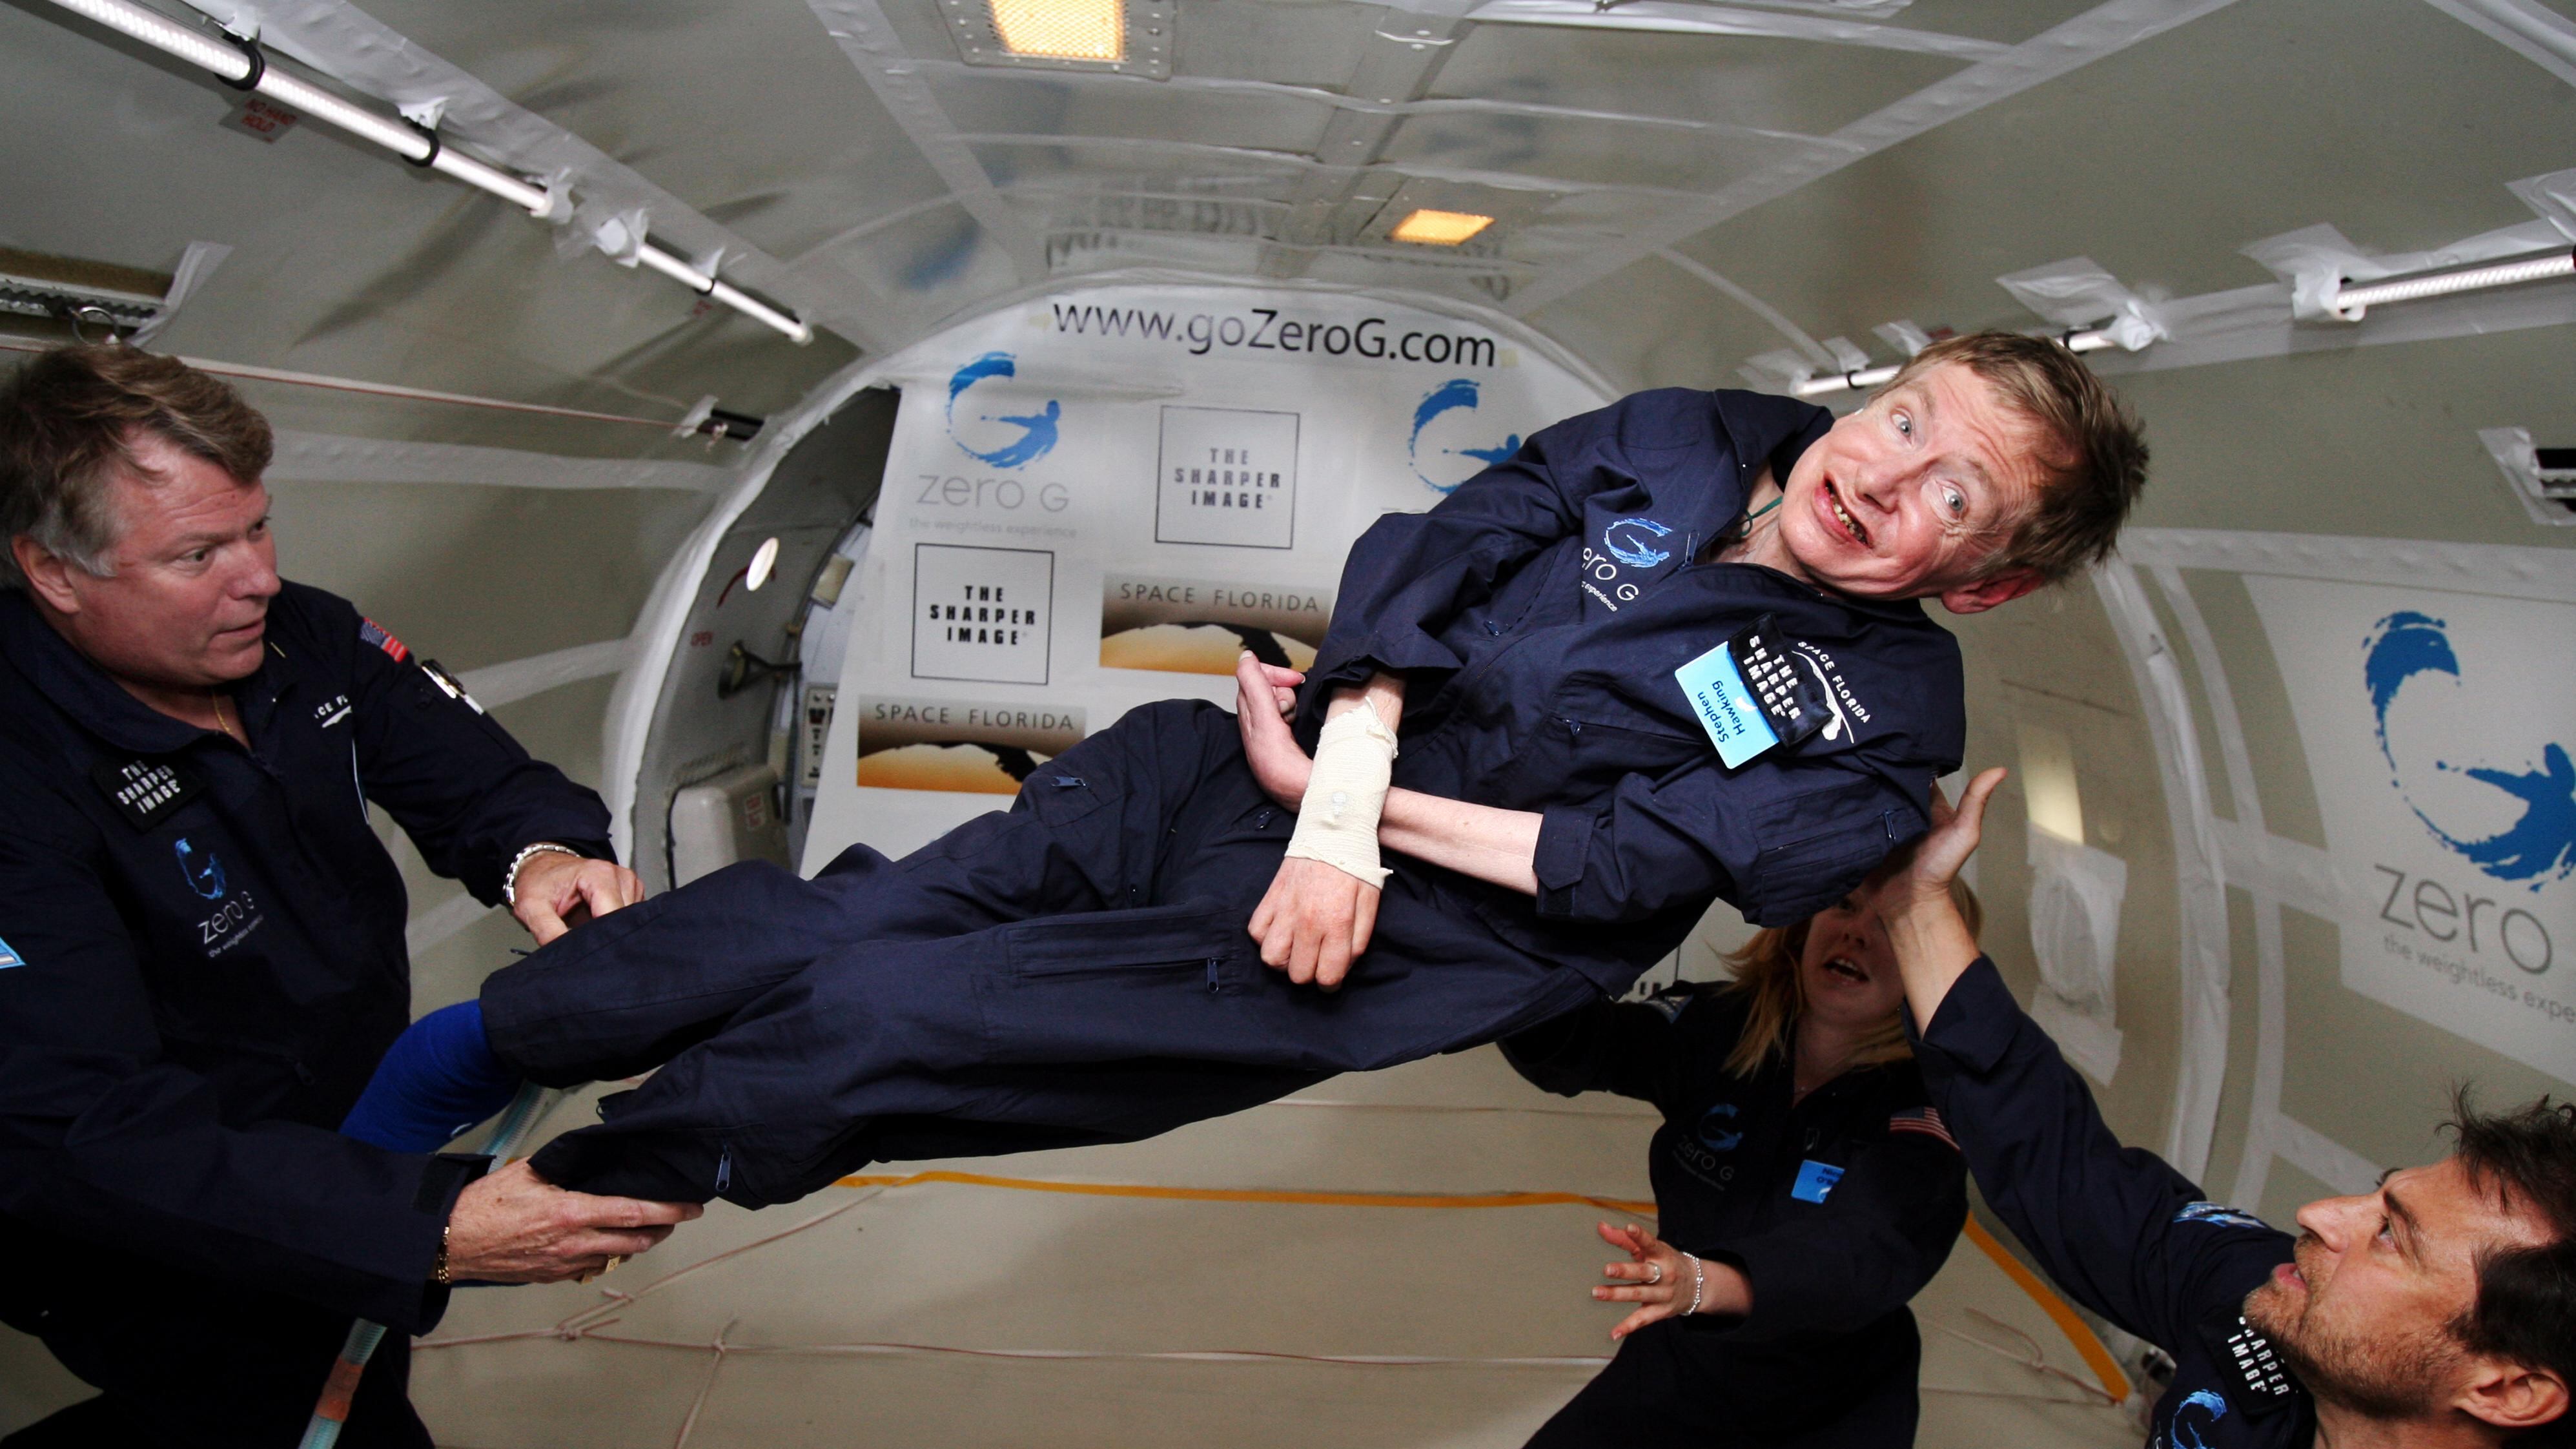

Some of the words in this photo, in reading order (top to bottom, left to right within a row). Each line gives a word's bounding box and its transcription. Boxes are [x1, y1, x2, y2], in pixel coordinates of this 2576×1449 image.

[1054, 303, 1496, 367] www.goZeroG.com
[1209, 447, 1249, 466] THE
[917, 475, 1025, 509] zero
[1040, 483, 1070, 512] G
[1174, 468, 1280, 489] SHARPER
[965, 585, 1003, 602] THE
[1120, 582, 1195, 604] SPACE
[1214, 589, 1319, 613] FLORIDA
[1617, 583, 1639, 601] G
[930, 604, 1036, 626] SHARPER
[1749, 635, 1801, 720] SHARPER
[1774, 654, 1798, 689] THE
[875, 703, 950, 724] SPACE
[969, 708, 1074, 731] FLORIDA
[1697, 692, 1730, 743] Stephen
[1712, 680, 1746, 735] Hawking
[1832, 674, 1872, 724] FLORIDA
[117, 765, 174, 805] SHARPER
[198, 900, 243, 945] zero
[2375, 863, 2553, 976] zero
[2384, 934, 2413, 960] the
[2417, 951, 2518, 1001] weightless
